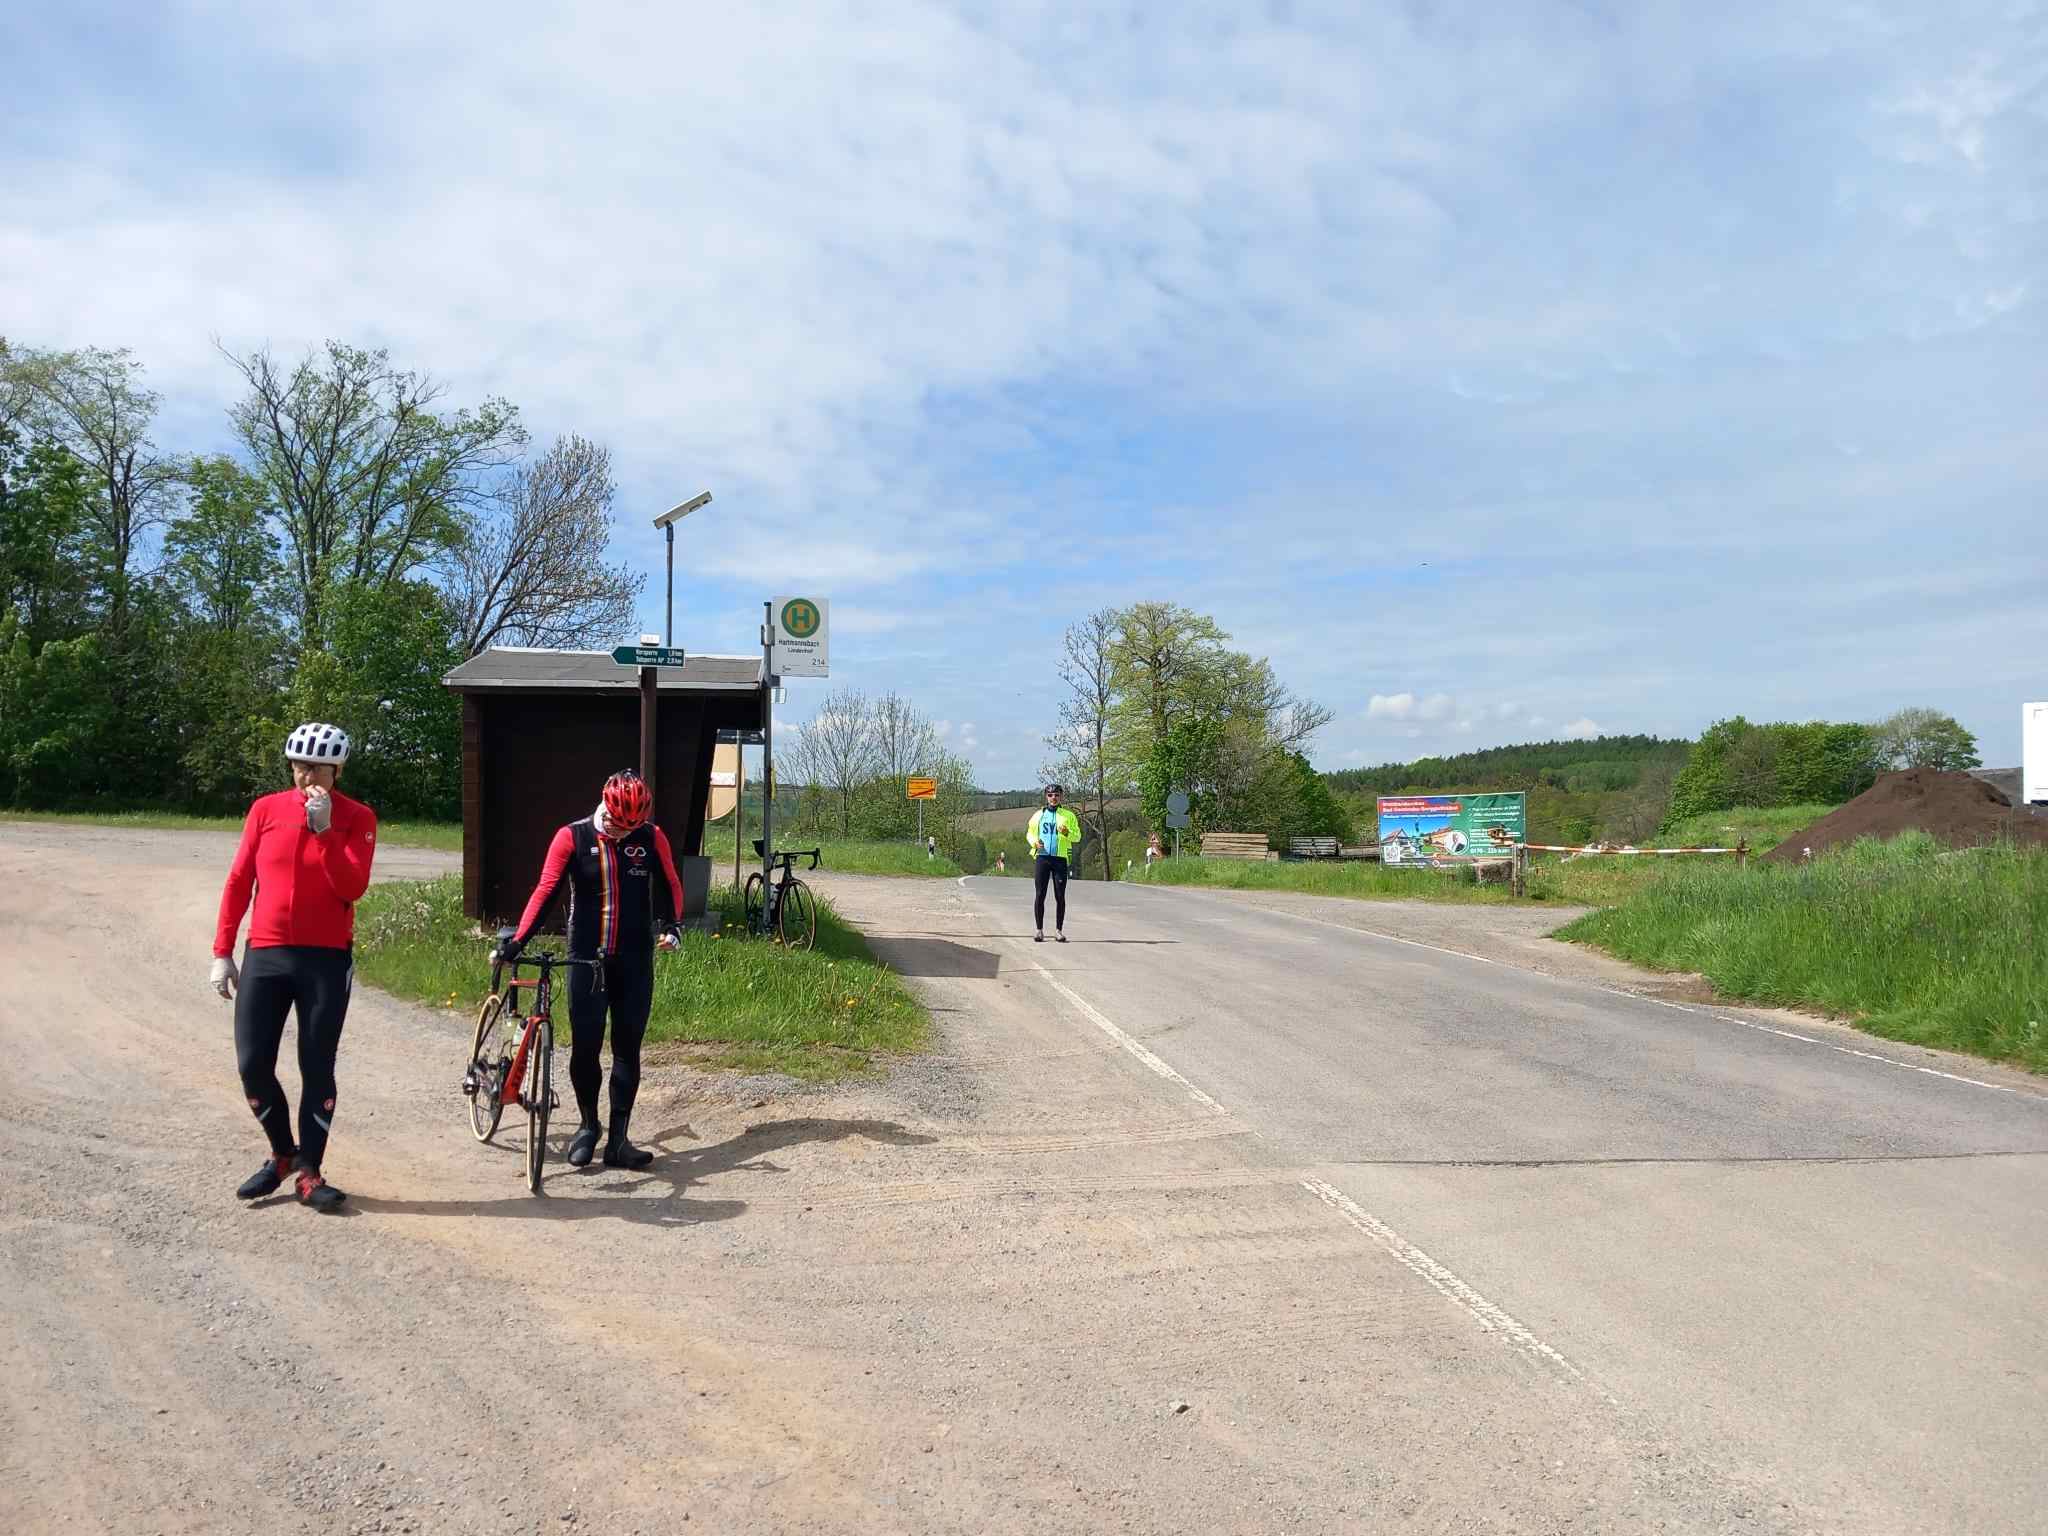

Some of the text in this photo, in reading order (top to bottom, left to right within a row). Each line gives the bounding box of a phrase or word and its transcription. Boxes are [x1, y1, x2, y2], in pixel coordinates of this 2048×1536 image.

[791, 607, 810, 628] H
[812, 658, 825, 666] 214
[1043, 822, 1059, 835] SY
